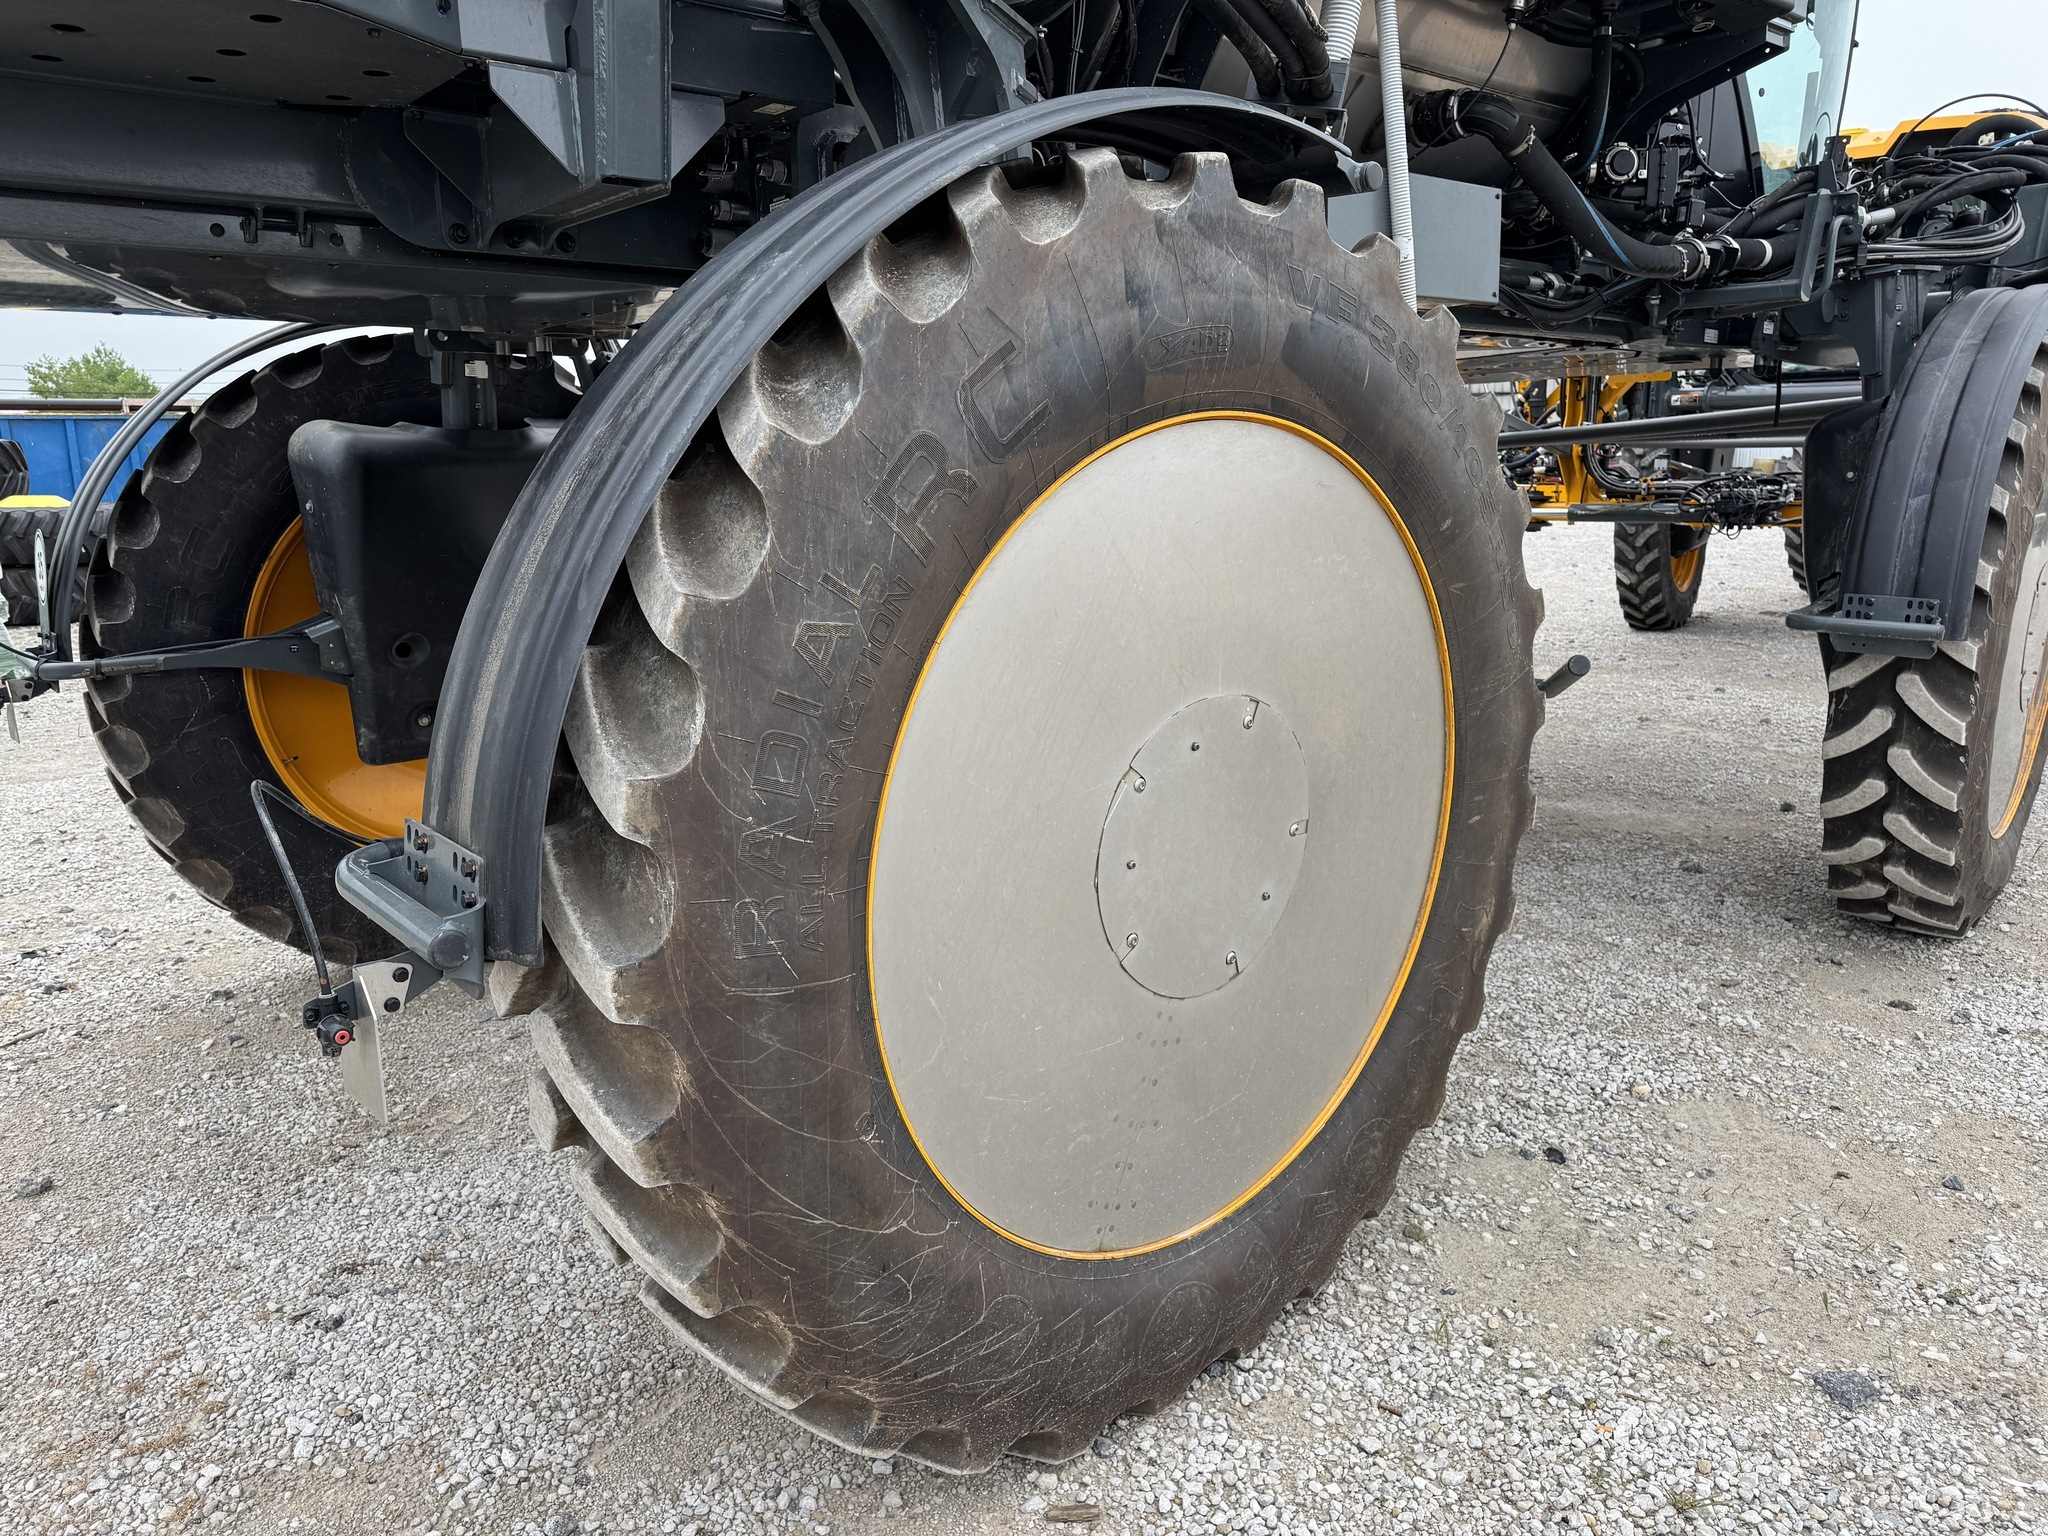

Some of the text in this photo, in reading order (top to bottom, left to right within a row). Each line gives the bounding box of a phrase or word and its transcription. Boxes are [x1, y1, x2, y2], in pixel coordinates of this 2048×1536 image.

[1287, 263, 1358, 325] VF
[734, 338, 1055, 961] RADIAL RC
[810, 574, 915, 845] TRACTION
[800, 856, 828, 952] ALL
